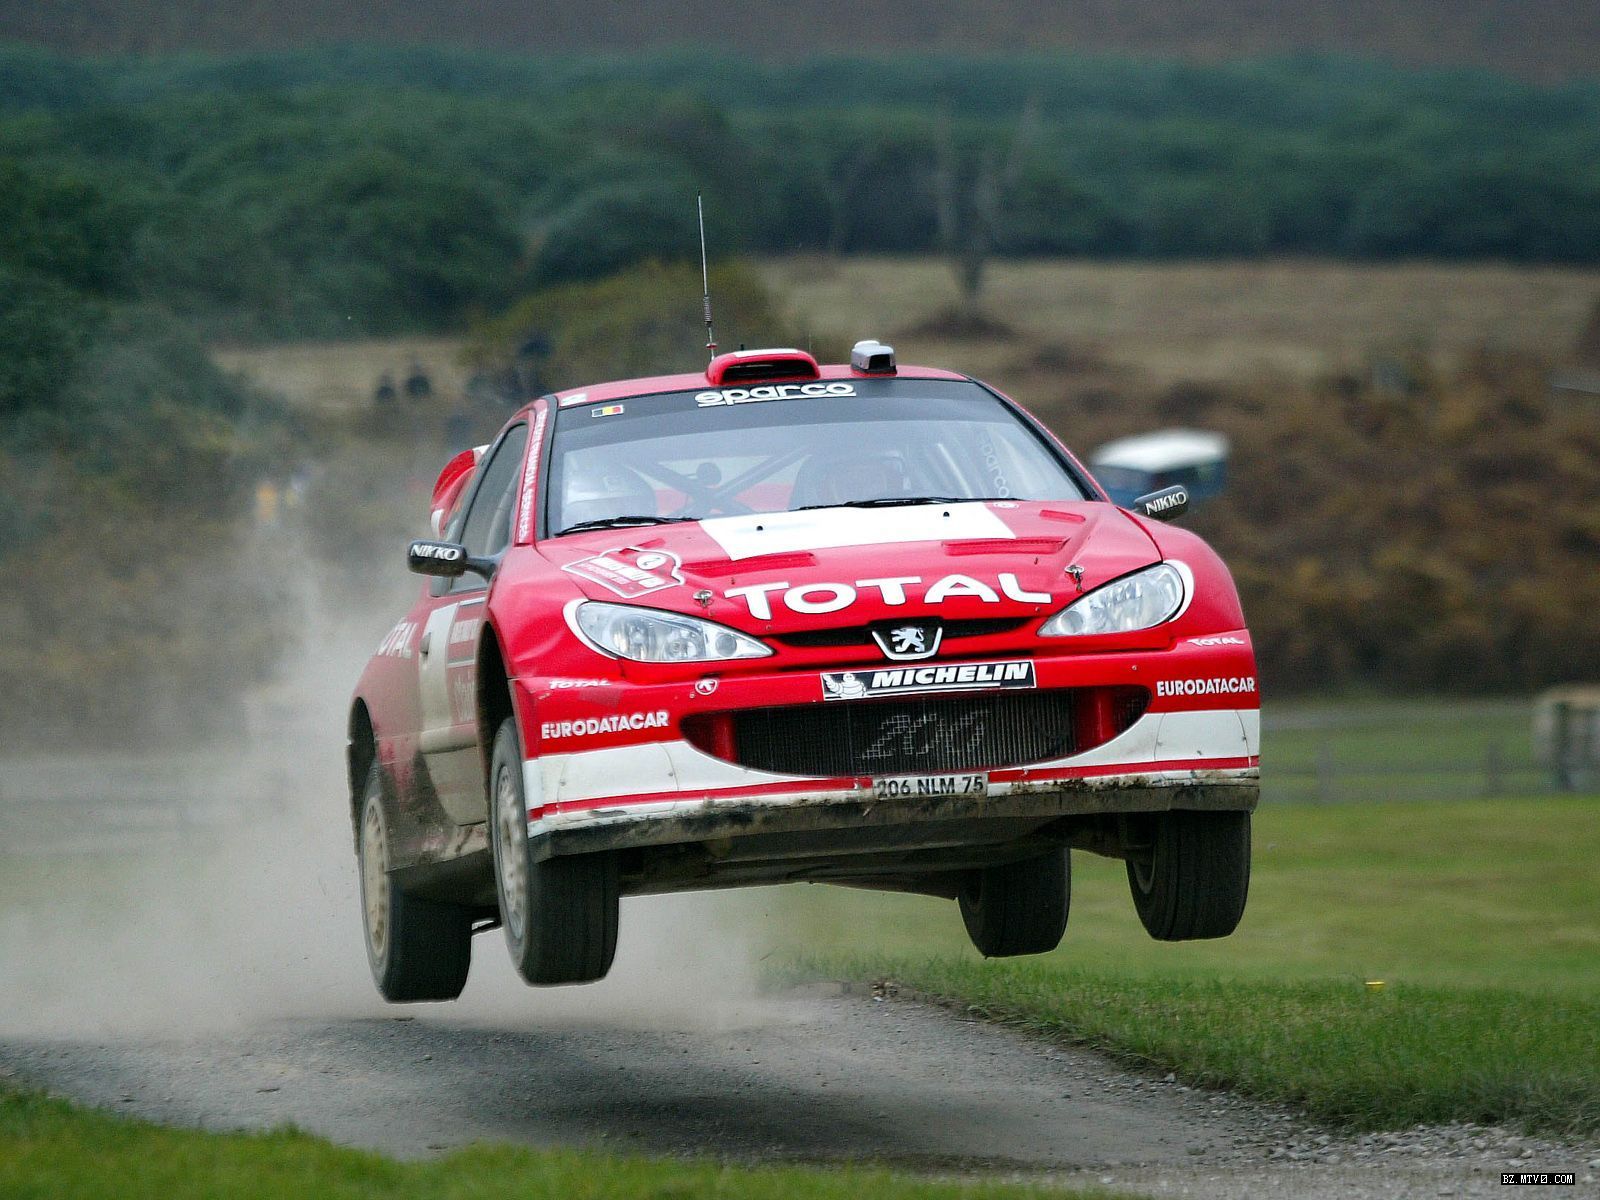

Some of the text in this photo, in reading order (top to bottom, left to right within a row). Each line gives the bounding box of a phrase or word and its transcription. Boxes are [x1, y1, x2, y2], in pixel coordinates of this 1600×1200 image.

[695, 382, 857, 406] sparco
[1145, 491, 1187, 515] NIKKO
[410, 544, 460, 560] NIKKO
[725, 573, 1051, 620] TOTAL
[373, 616, 419, 660] OTAL
[1187, 637, 1245, 647] TOTAL
[549, 679, 612, 690] TOTAL
[871, 663, 1029, 688] MICHELIN
[1156, 678, 1255, 697] EURODATACAR
[541, 711, 670, 740] EURODATACAR
[874, 776, 984, 798] 206 NLM 75
